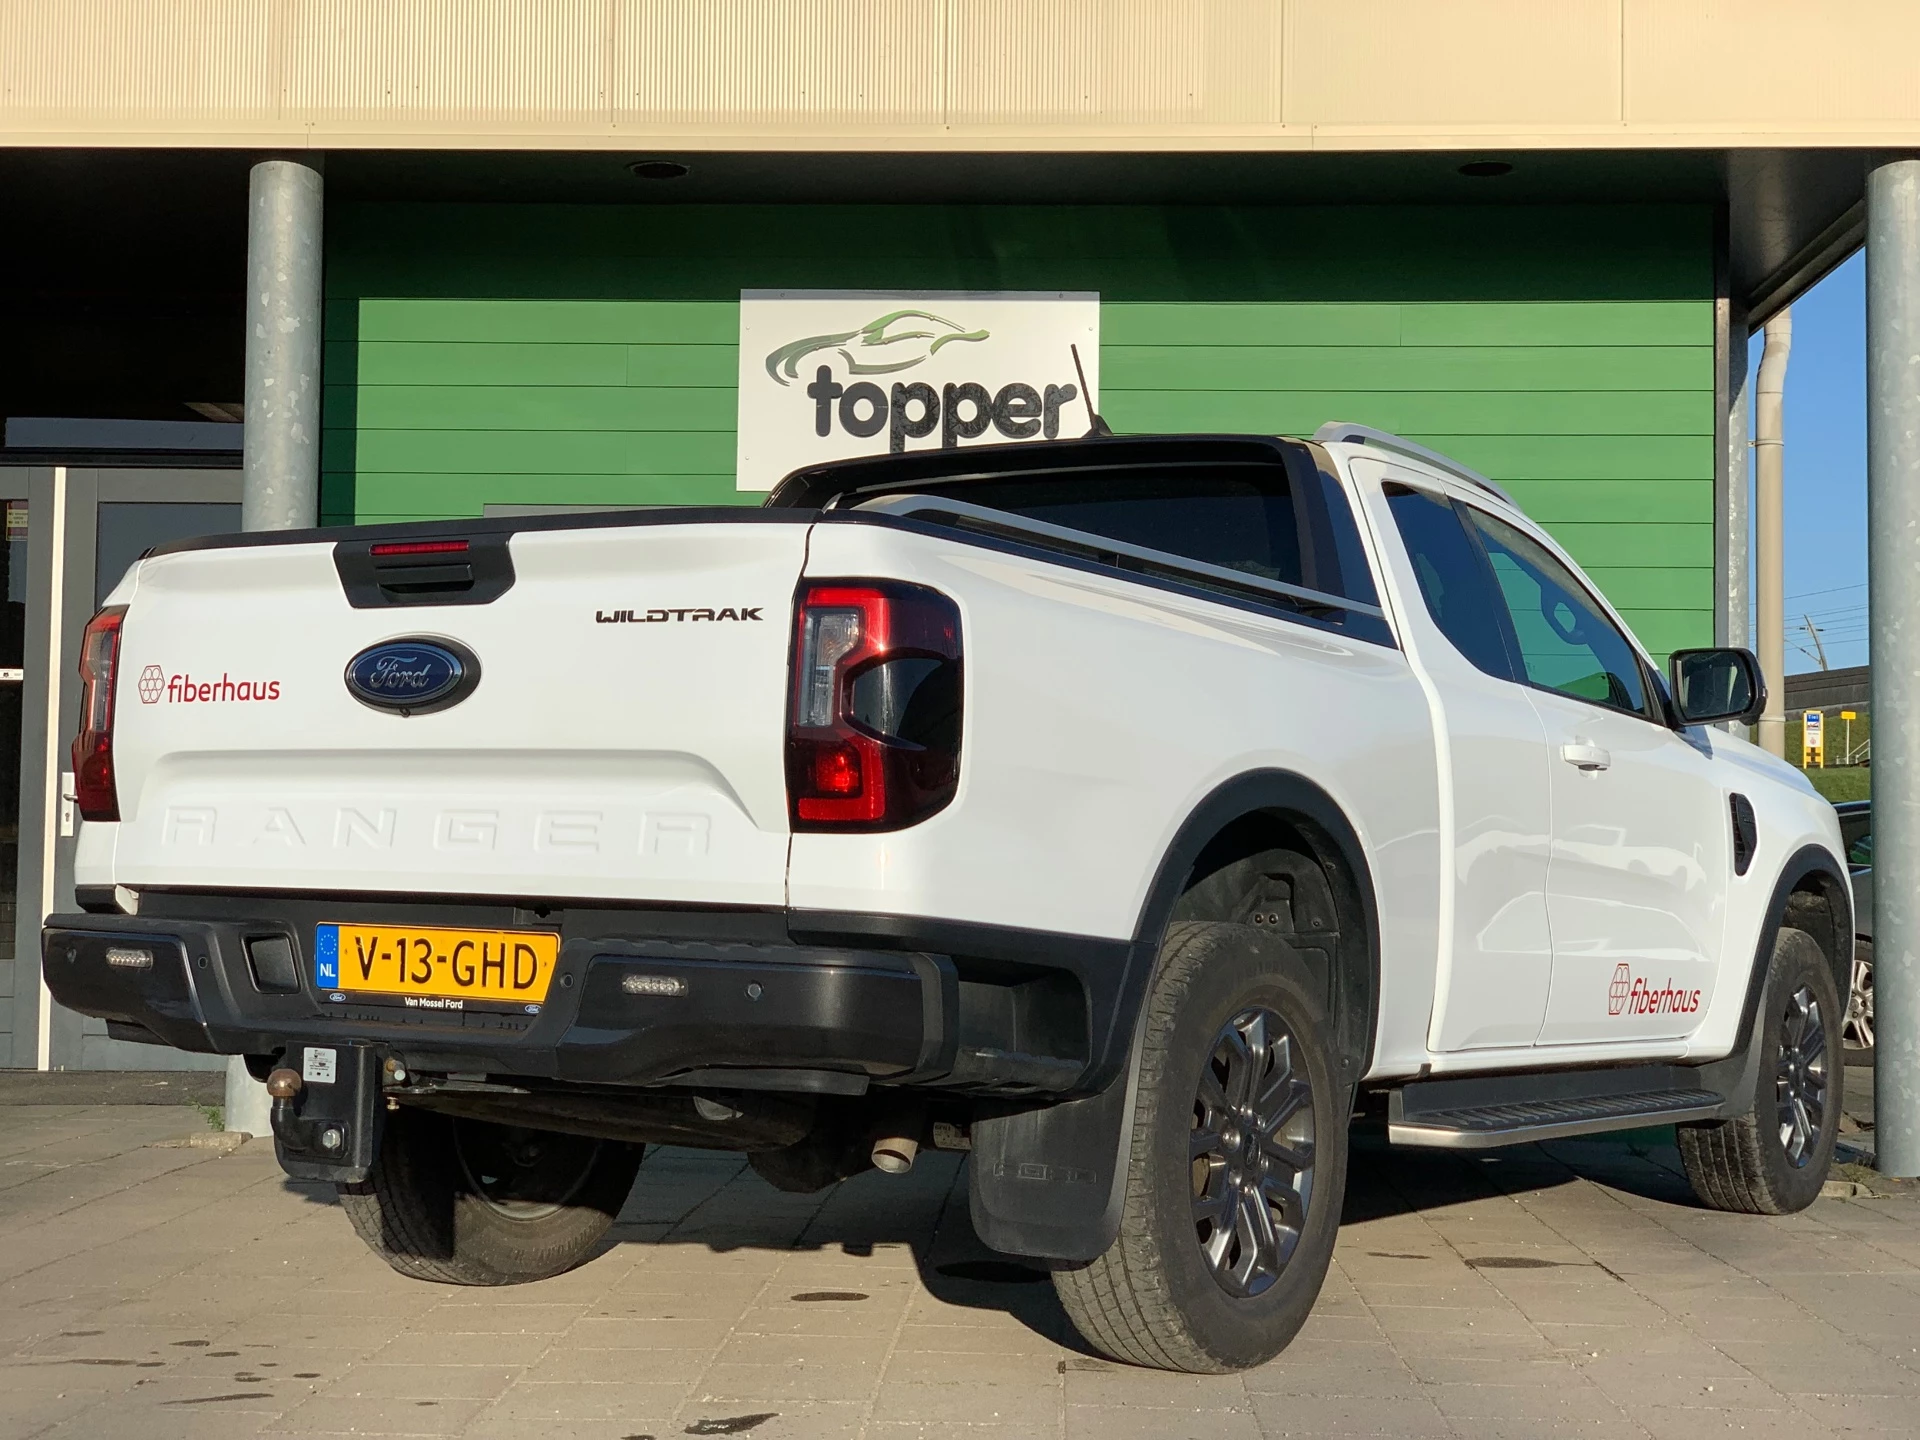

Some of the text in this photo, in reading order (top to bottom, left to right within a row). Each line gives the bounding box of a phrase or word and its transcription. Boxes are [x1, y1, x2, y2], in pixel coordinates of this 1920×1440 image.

[807, 365, 1078, 453] topper
[596, 608, 764, 623] WILDTRAK
[167, 673, 280, 703] fiberhaus
[369, 655, 432, 688] Ford
[161, 804, 713, 857] RANGER
[320, 963, 336, 977] NL
[355, 935, 538, 990] V-13-GHD
[405, 997, 463, 1009] Van Mossel Ford
[1628, 978, 1700, 1015] fiberhaus
